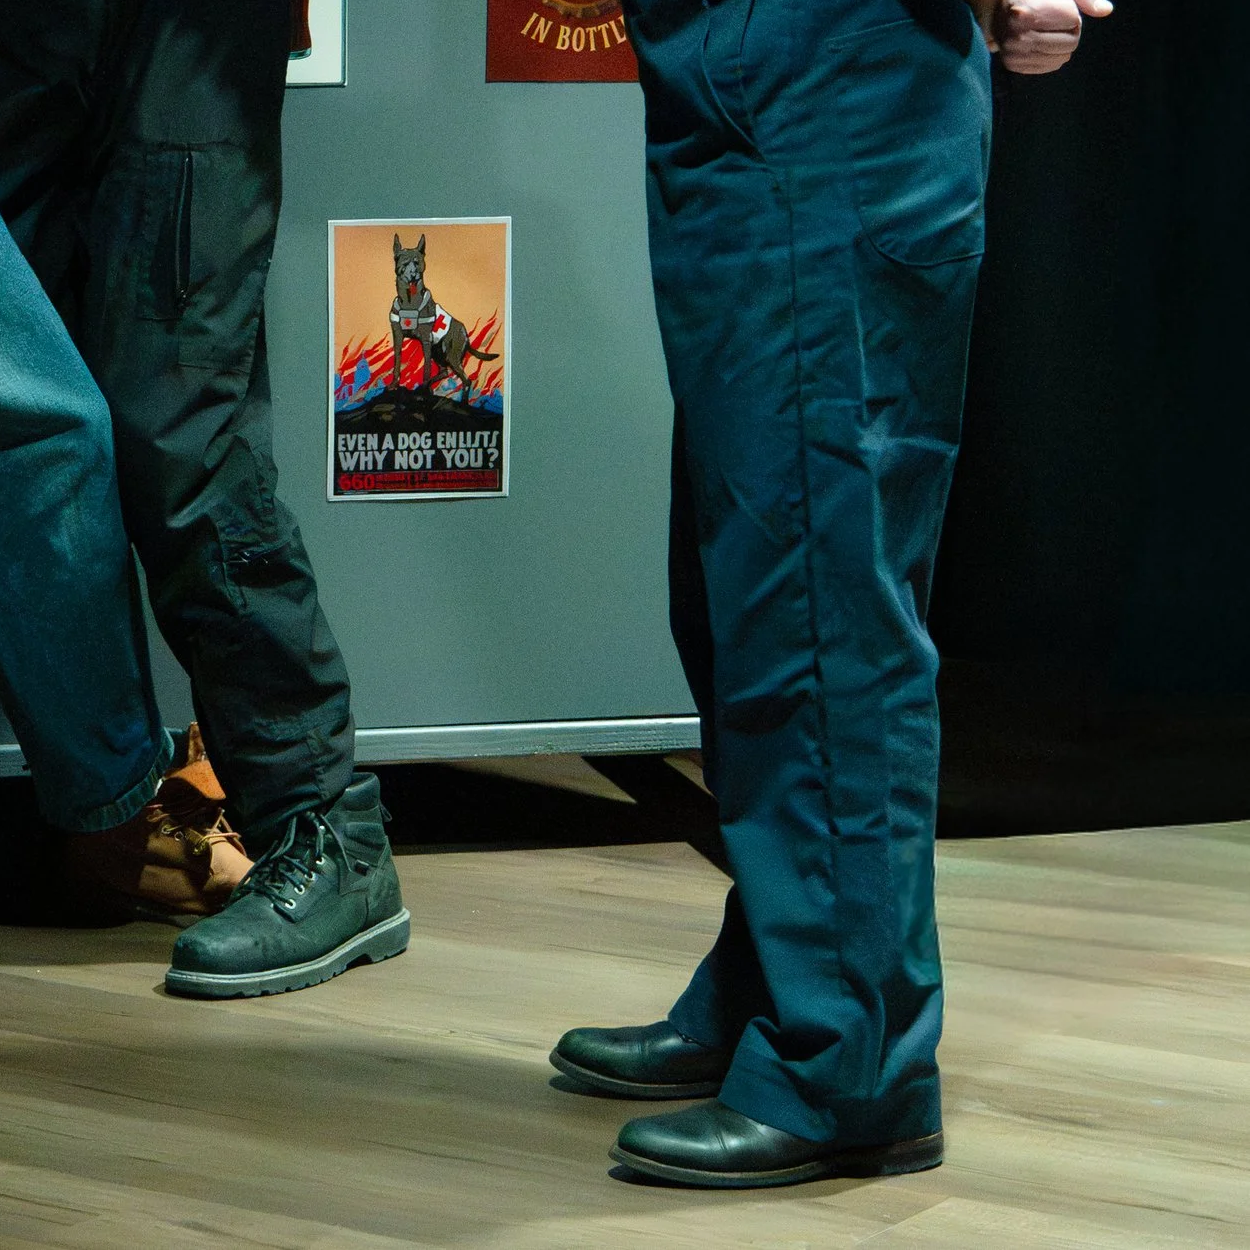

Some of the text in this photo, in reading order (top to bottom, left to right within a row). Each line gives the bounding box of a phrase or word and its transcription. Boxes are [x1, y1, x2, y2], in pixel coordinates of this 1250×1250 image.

[521, 12, 553, 44] IN
[337, 430, 499, 451] EVEN A DOG ENLISTS
[338, 450, 386, 472] WHY
[394, 449, 437, 470] NOT
